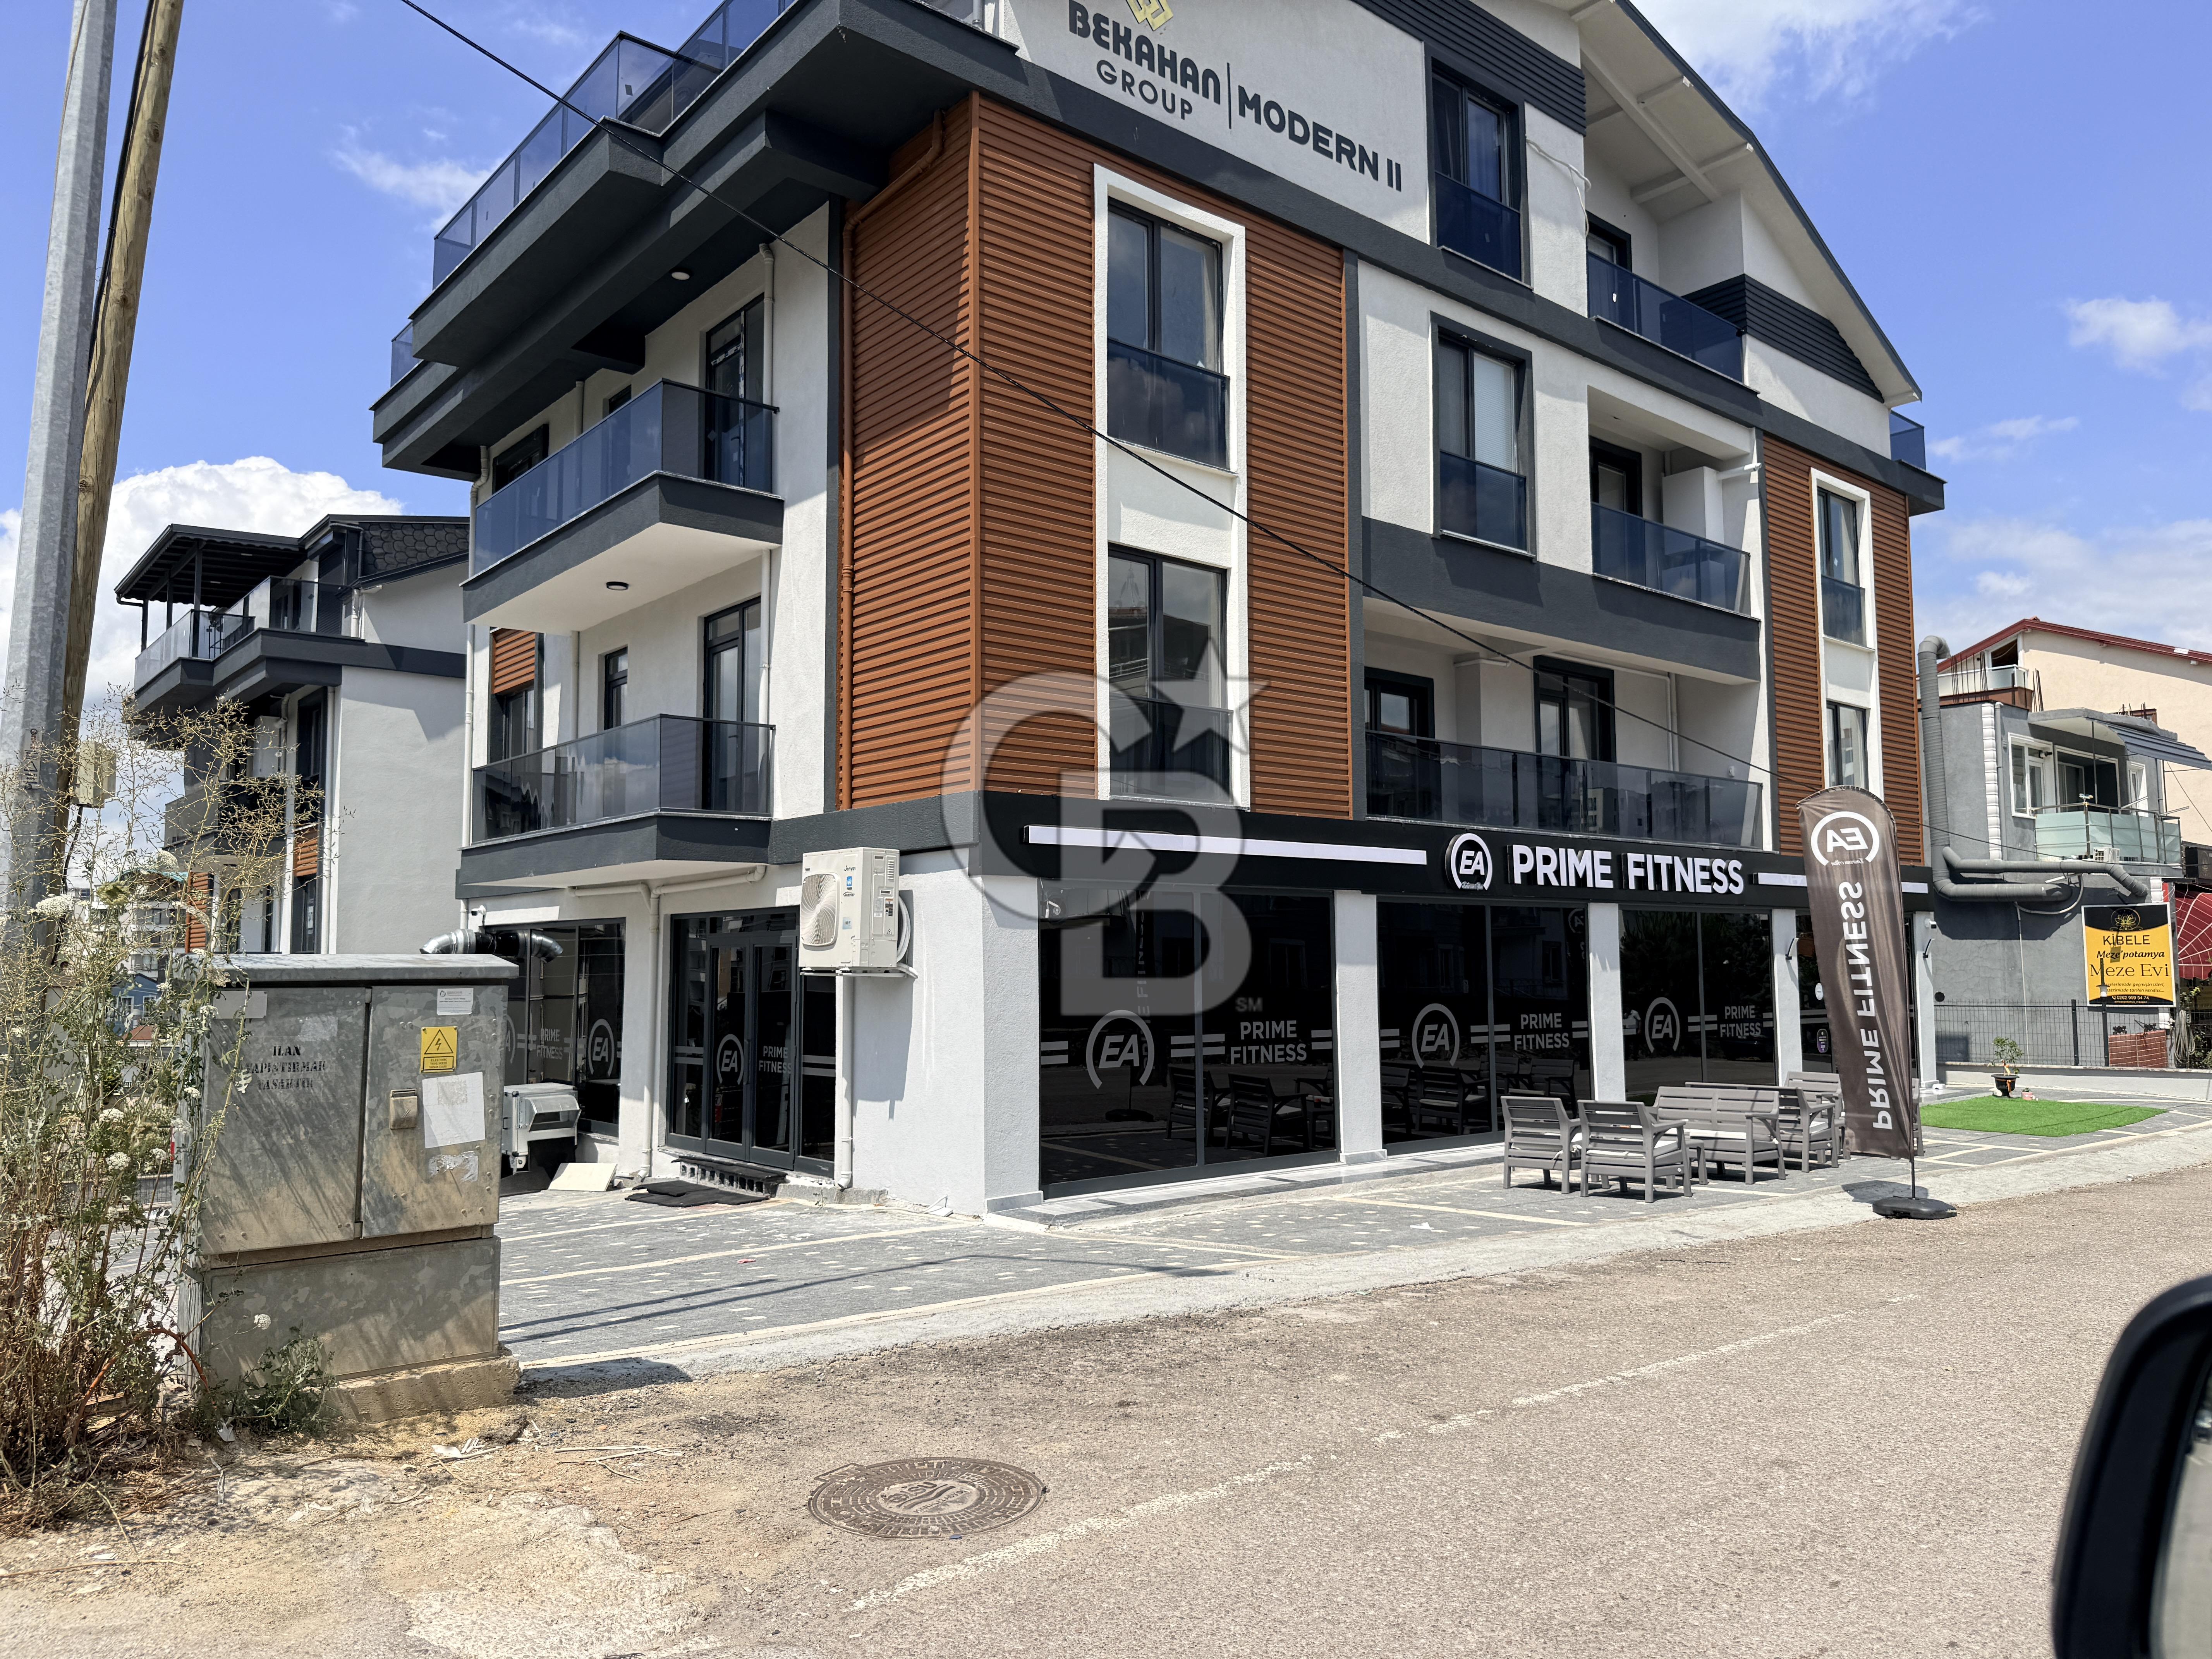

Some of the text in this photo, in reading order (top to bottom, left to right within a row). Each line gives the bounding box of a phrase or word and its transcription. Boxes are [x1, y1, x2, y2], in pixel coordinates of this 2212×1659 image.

[1069, 0, 1221, 105] BEKAHAN
[1096, 60, 1192, 120] GROUP
[1238, 85, 1378, 182] MODERN
[1460, 850, 1485, 875] EA
[1512, 845, 1743, 895] PRIME FITNESS
[2103, 934, 2150, 945] KİBELE
[2090, 963, 2169, 977] Meze Evi
[1520, 1013, 1562, 1030] PRIME
[1724, 1005, 1755, 1020] PRIME
[541, 1028, 560, 1042] PRIME
[1240, 1020, 1297, 1040] PRIME
[1652, 1015, 1673, 1039] EA
[1720, 1022, 1761, 1037] FITNESS
[1420, 1024, 1449, 1052] EA
[1513, 1032, 1570, 1050] FITNESS
[537, 1044, 563, 1060] FITNESS
[592, 1037, 609, 1062] EA
[763, 1046, 788, 1058] PRIME
[1098, 1034, 1140, 1068] EA
[1230, 1043, 1307, 1065] FITNESS
[721, 1050, 738, 1072] EA
[759, 1060, 792, 1075] FITNESS
